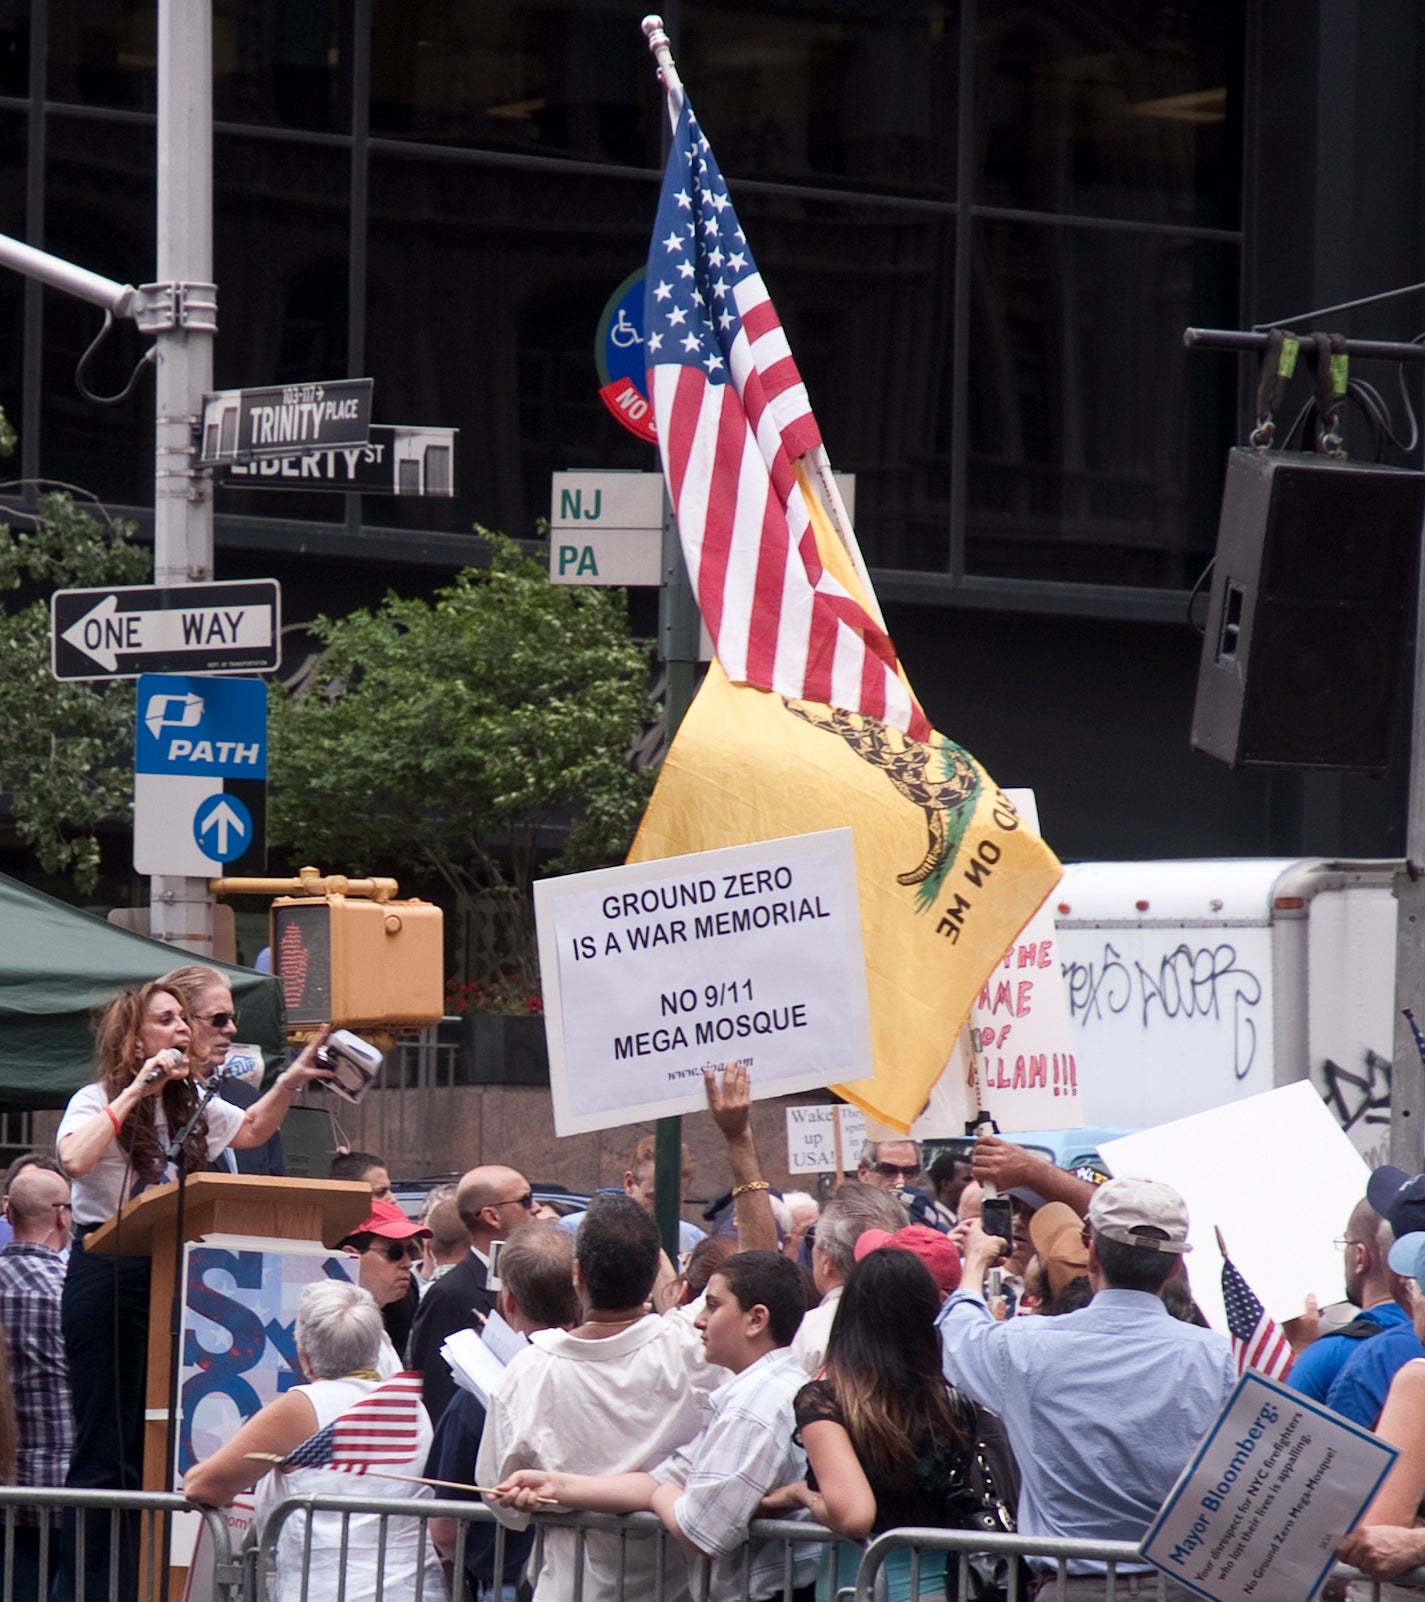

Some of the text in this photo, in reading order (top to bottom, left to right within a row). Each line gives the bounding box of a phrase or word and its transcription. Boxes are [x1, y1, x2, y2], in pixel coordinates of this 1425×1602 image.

[282, 386, 316, 404] 103-117
[615, 387, 648, 420] NO
[250, 399, 359, 444] TRINITY PLACE
[364, 444, 385, 463] ST
[560, 488, 602, 520] NJ
[559, 546, 599, 576] PA
[84, 611, 245, 650] ONE WAY
[168, 739, 260, 765] PATH
[602, 866, 793, 919] GROUND ZERO
[573, 896, 831, 961] IS A WAR MEMORIAL
[661, 978, 753, 1016] NO 9/11
[978, 979, 1034, 1018] AME
[614, 1004, 808, 1060] MEGA MOSQUE
[791, 1108, 834, 1123] Wake
[793, 1151, 836, 1167] USA!
[804, 1134, 823, 1148] up
[1168, 1402, 1279, 1566] Mayor Bloomberg:
[1194, 1411, 1303, 1582] Your disrespect for NYC firefighters
[1218, 1434, 1313, 1581] who lost their lives is appalling.
[1242, 1447, 1337, 1596] No Ground Zero Mega-Mosque!
